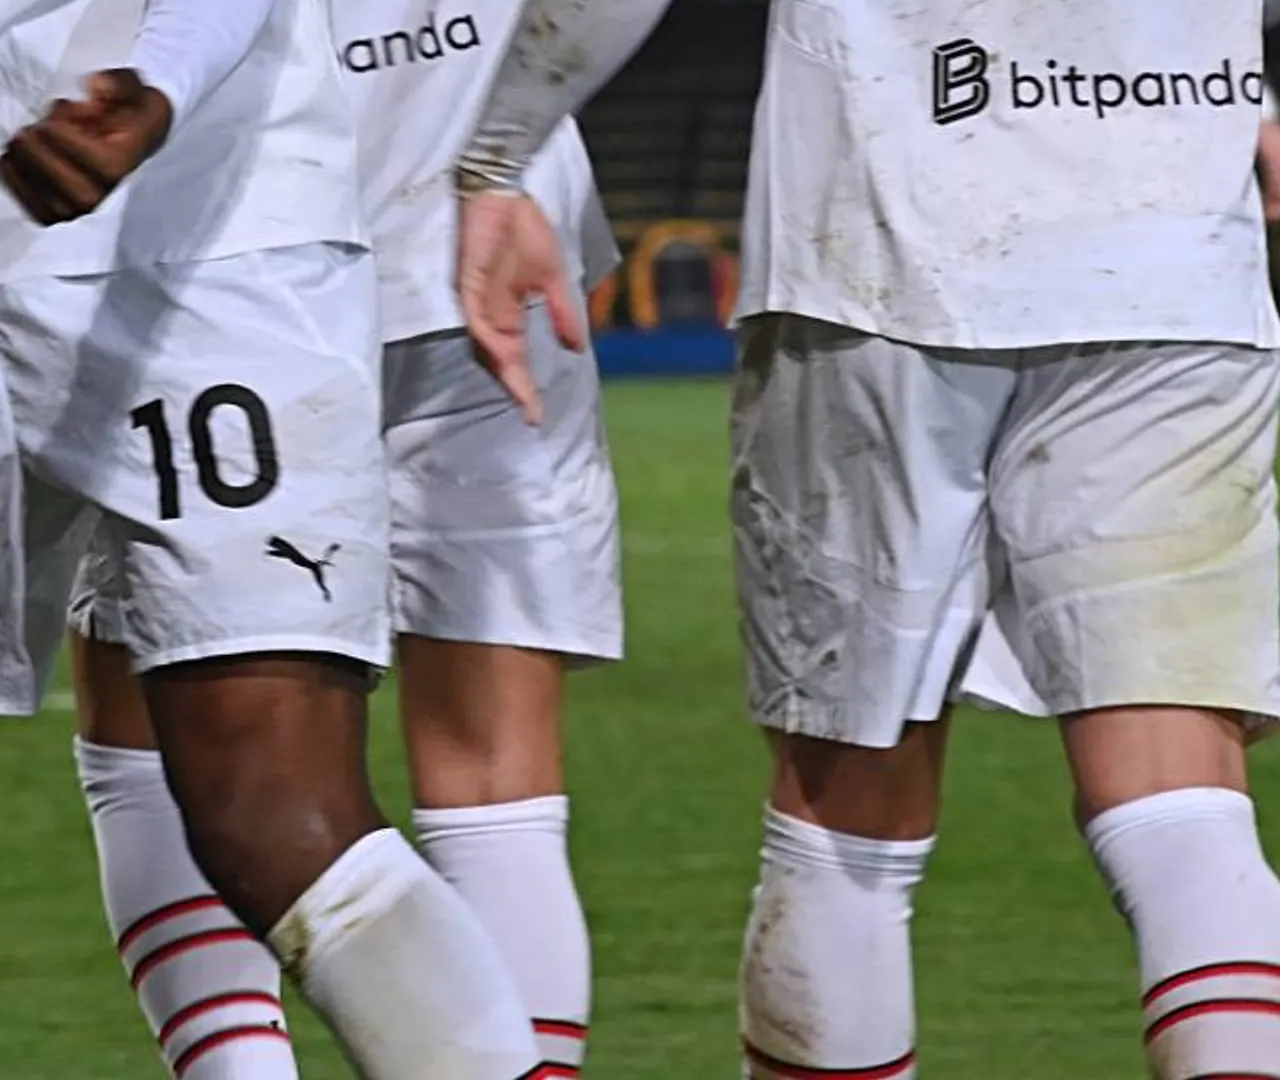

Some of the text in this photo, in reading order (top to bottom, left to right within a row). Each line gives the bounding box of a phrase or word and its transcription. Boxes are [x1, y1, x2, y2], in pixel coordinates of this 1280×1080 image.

[336, 10, 480, 73] anda
[1010, 58, 1263, 119] bitpanda
[129, 383, 281, 521] 10
